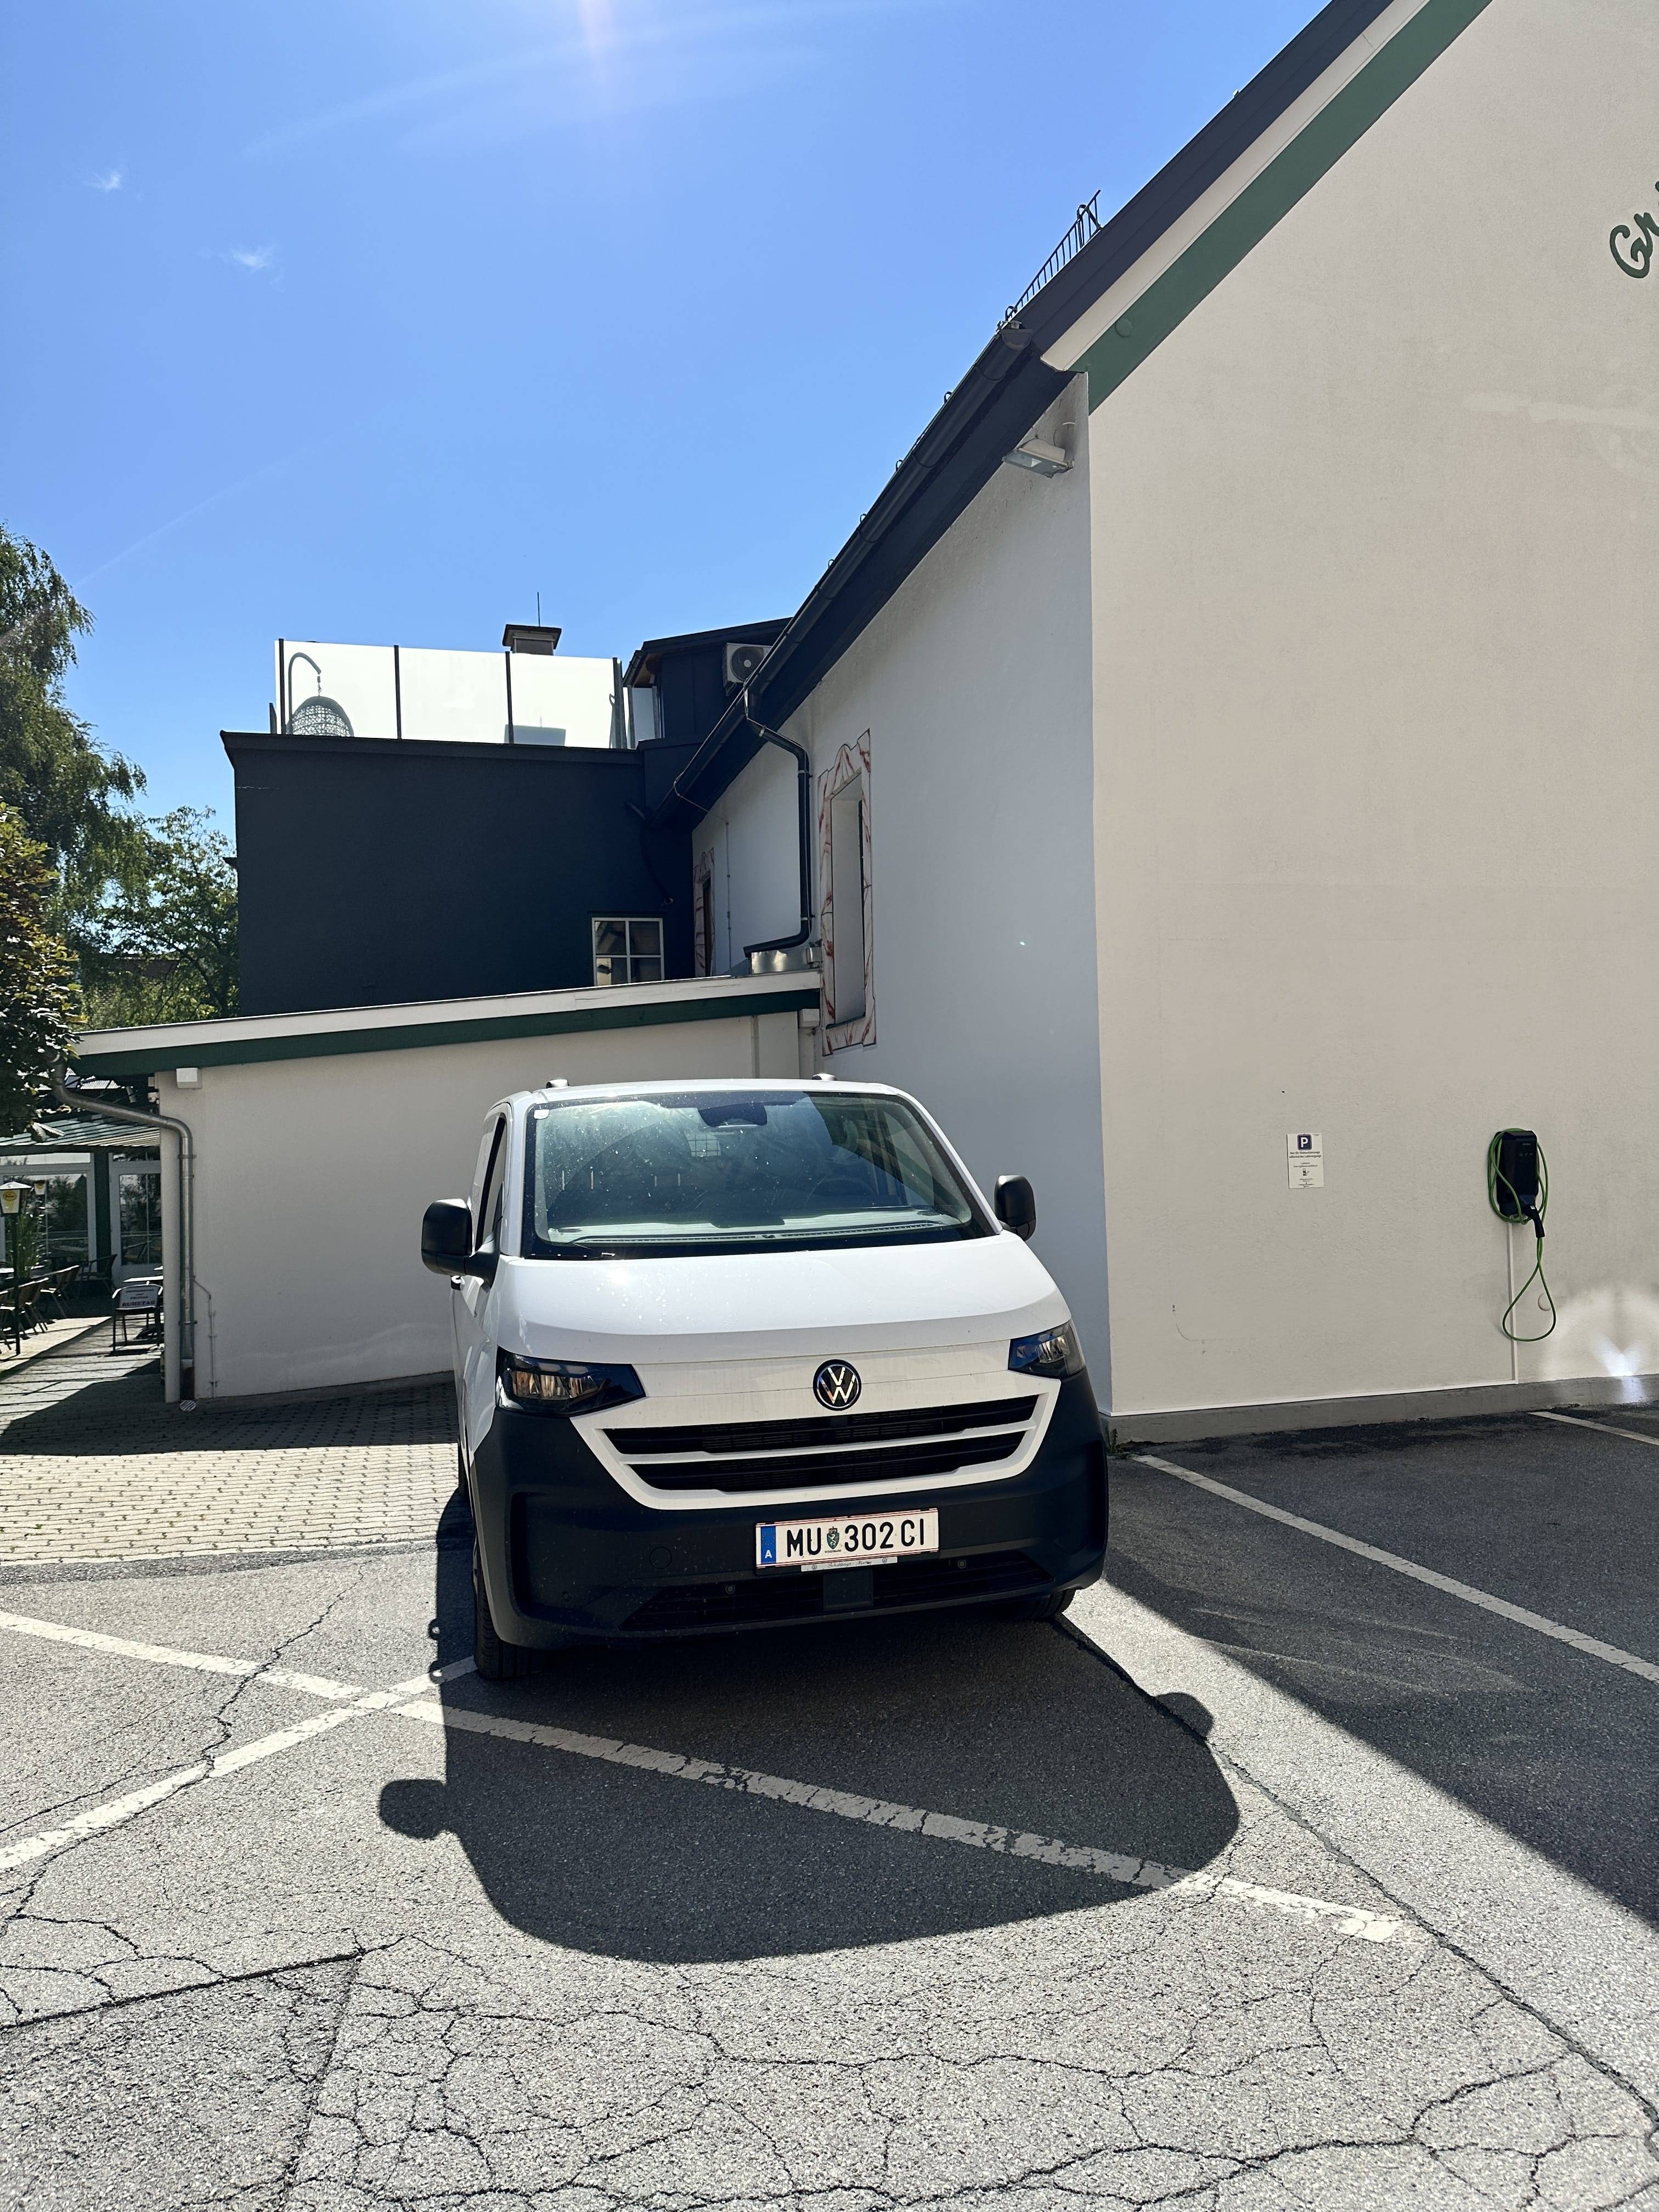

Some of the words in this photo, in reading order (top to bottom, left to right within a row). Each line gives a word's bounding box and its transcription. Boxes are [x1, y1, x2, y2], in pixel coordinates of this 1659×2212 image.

[1610, 180, 1659, 279] Gr
[1300, 1137, 1308, 1148] P
[787, 1527, 821, 1557] MU
[844, 1522, 894, 1552] 302
[901, 1518, 924, 1547] CI
[764, 1549, 772, 1559] A
